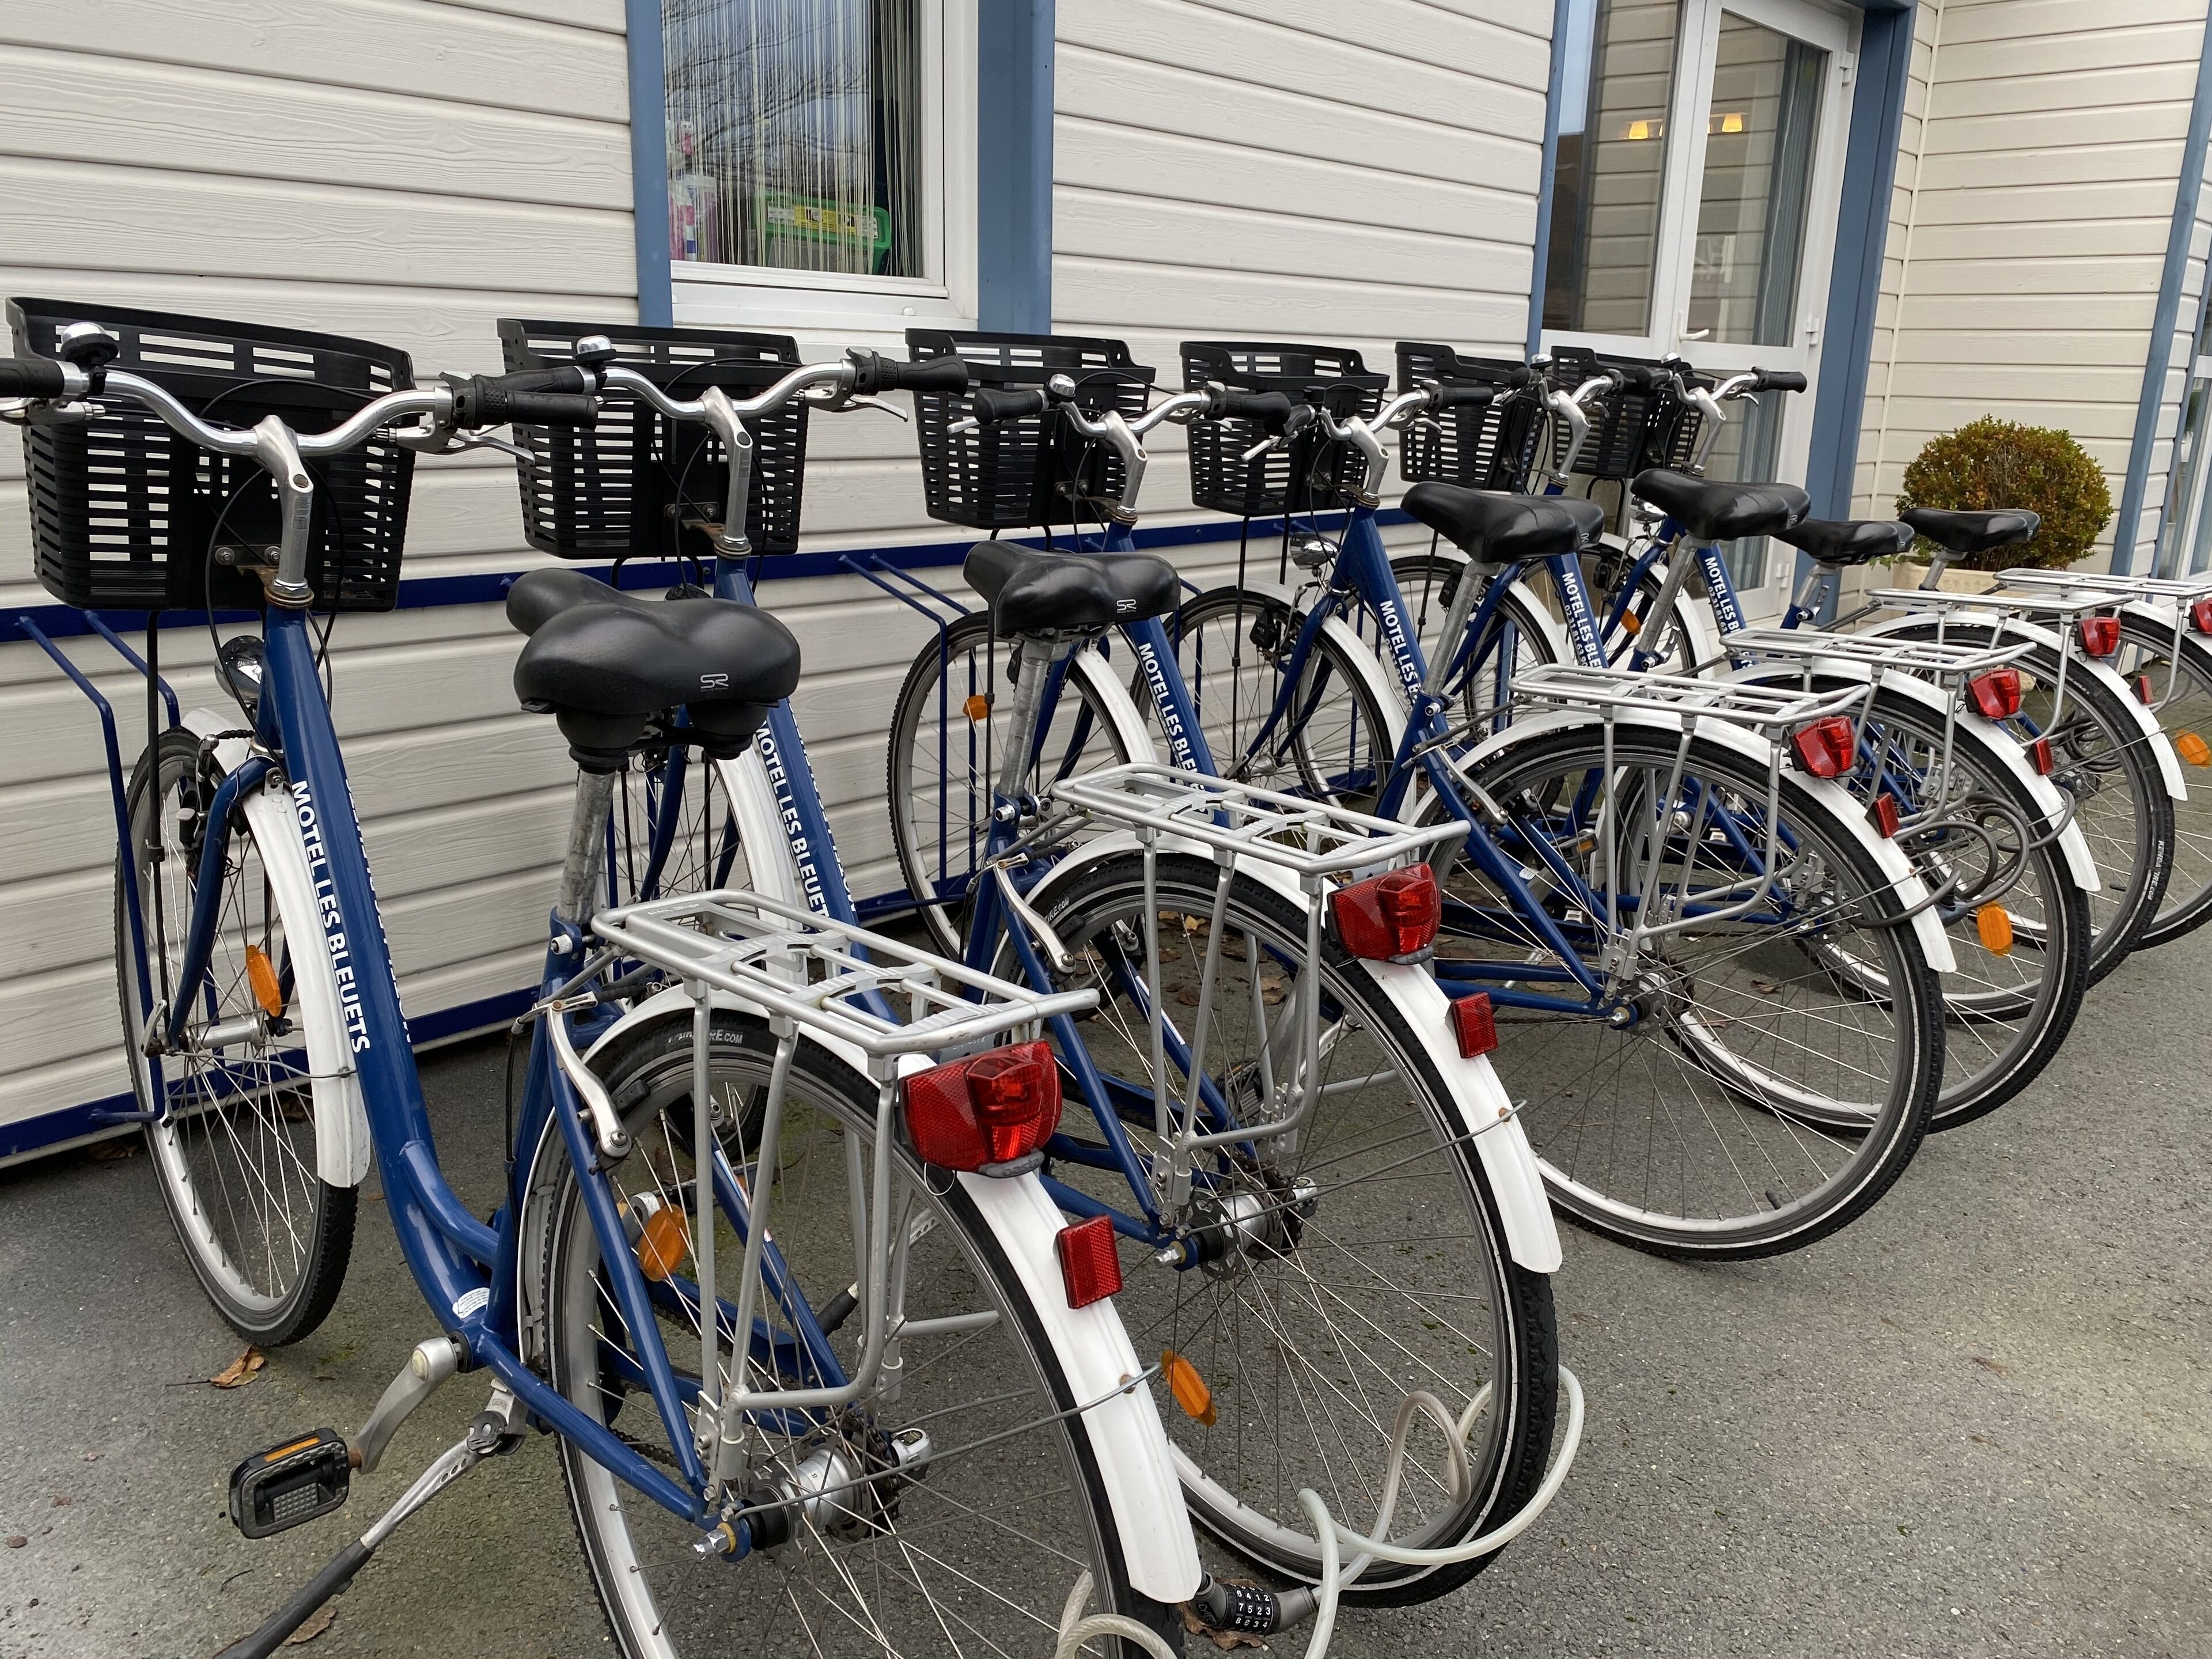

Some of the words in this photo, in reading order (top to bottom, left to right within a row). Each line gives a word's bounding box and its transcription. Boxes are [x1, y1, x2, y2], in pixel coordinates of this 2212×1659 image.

[1562, 572, 1585, 618] MOTEL
[1577, 618, 1593, 642] LES
[1564, 605, 1572, 618] 02
[1705, 556, 1728, 599] MOTEL
[1719, 598, 1736, 620] LES
[1380, 600, 1407, 654] MOTEL
[1398, 654, 1418, 683] LES
[1138, 642, 1169, 704] MOTEL
[1161, 704, 1183, 736] LES
[778, 793, 802, 836] LES
[791, 837, 830, 918] BLEUET
[291, 780, 327, 877] MOTEL
[315, 878, 340, 929] LES
[328, 931, 370, 1054] BLEUETS
